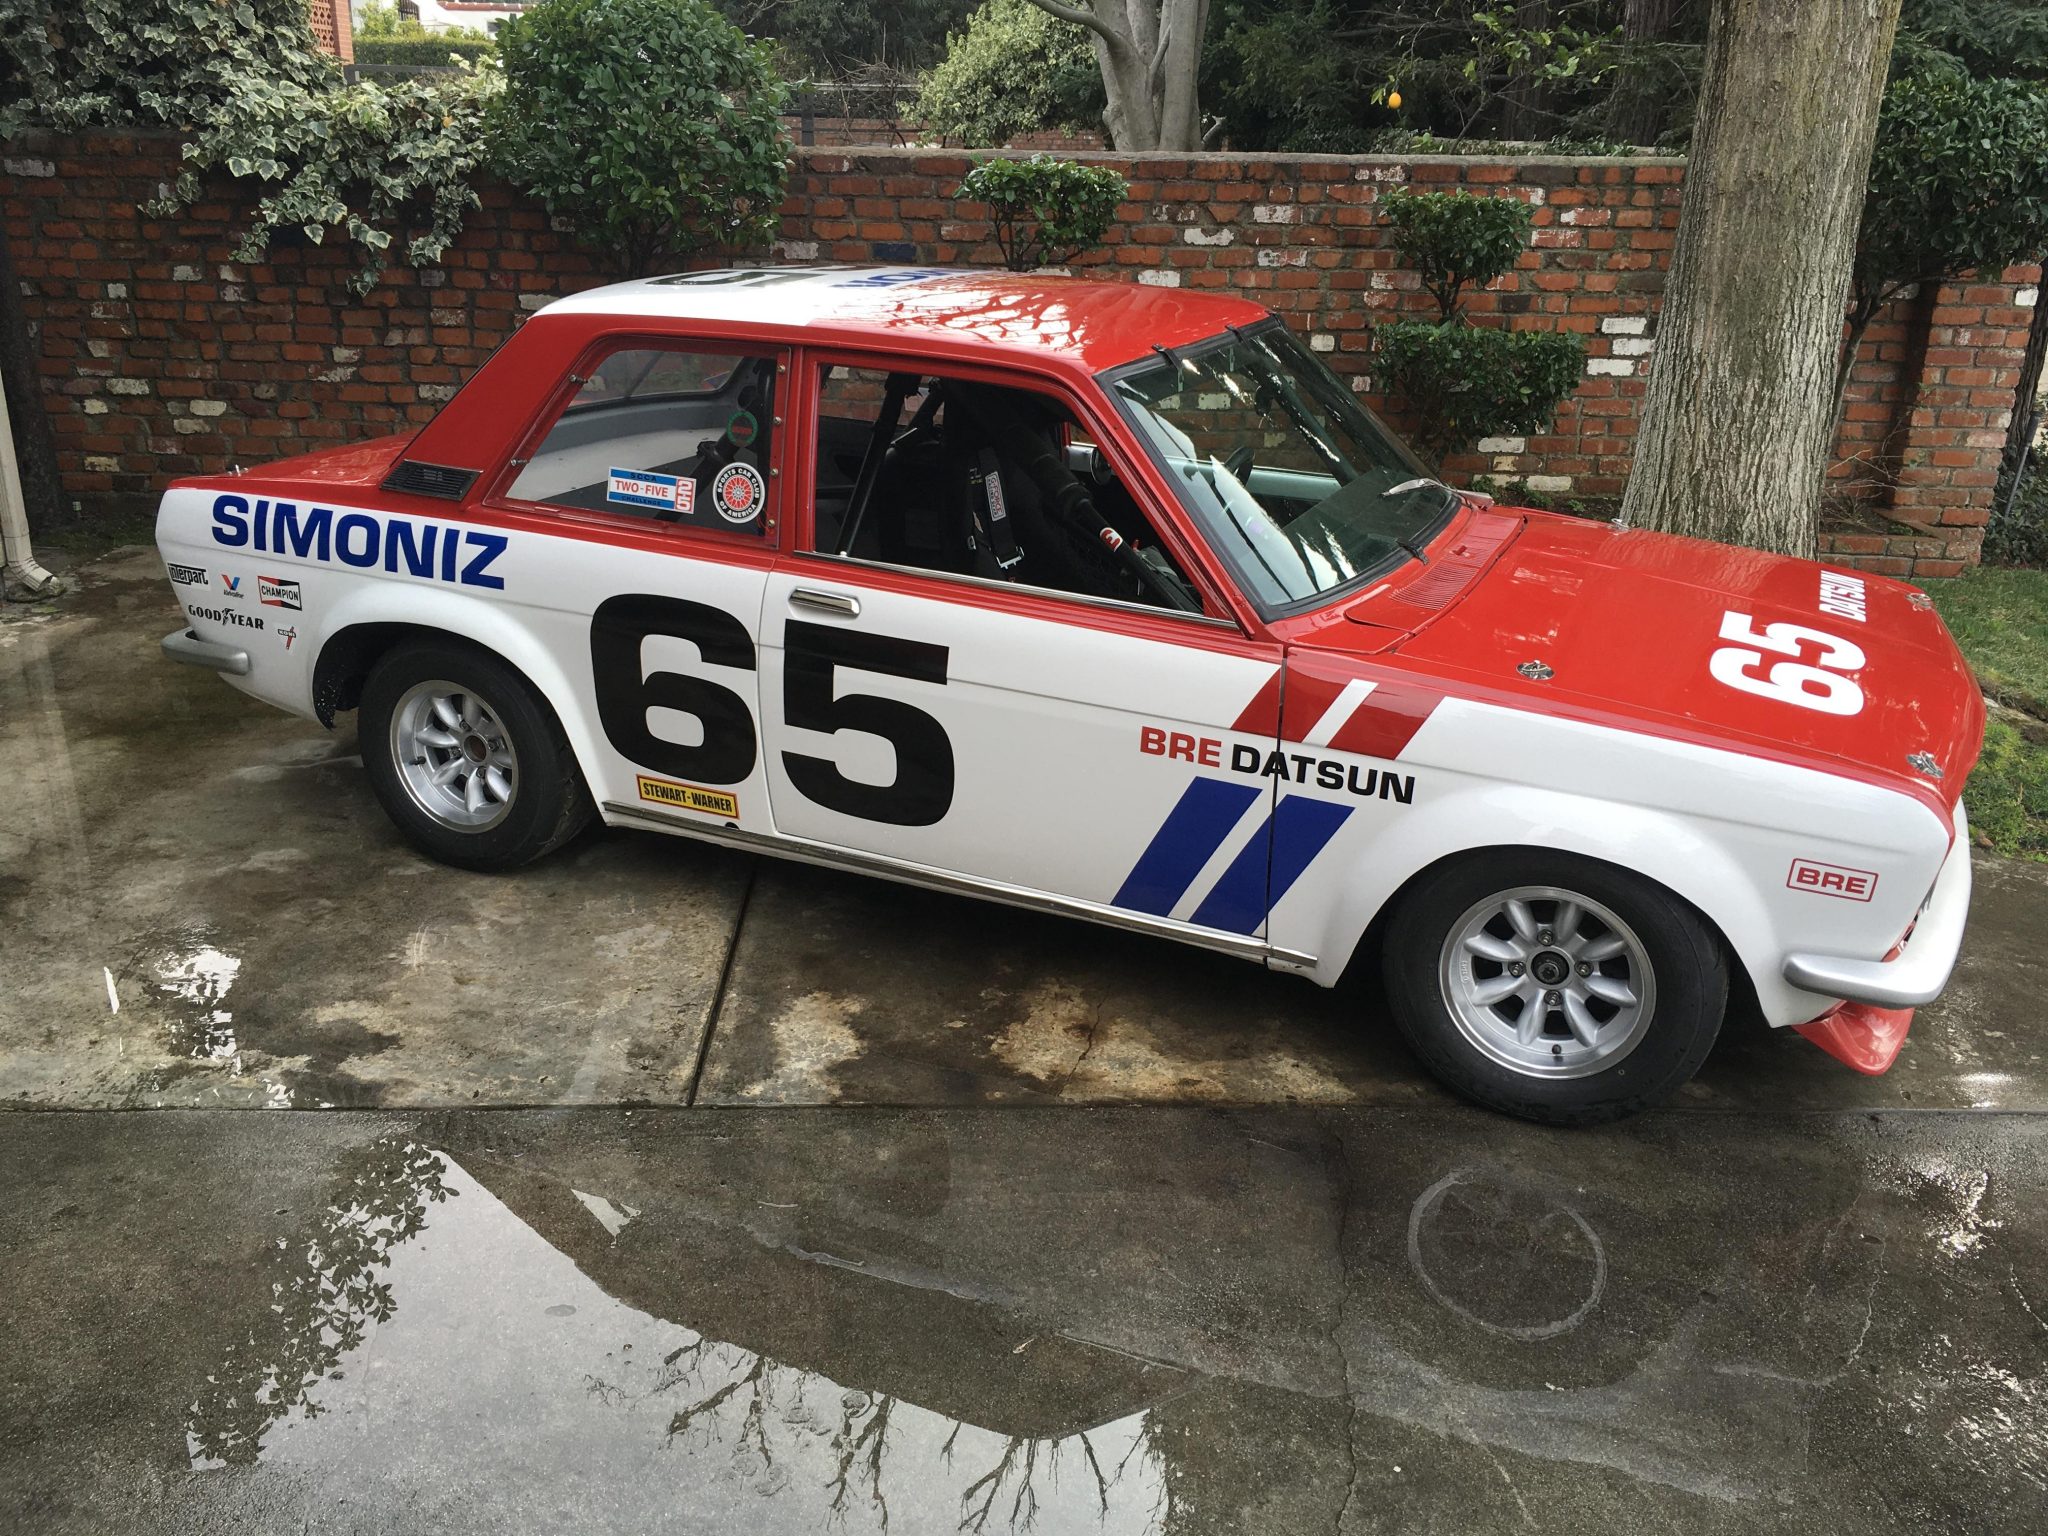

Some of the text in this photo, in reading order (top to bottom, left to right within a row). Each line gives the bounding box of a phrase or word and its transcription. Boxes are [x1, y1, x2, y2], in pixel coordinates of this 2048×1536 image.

[630, 473, 657, 481] SCCA
[717, 468, 760, 499] SPORTS CAR CLUB
[621, 495, 662, 506] CHALLENGE
[720, 500, 757, 518] OF AMERICA
[211, 494, 509, 591] SIMONIZ
[260, 585, 299, 601] CHAMPION
[1818, 570, 1867, 623] DATSUN
[1709, 610, 1866, 716] 65
[590, 593, 955, 827] 65
[1139, 725, 1416, 805] BRE DATSUN
[643, 782, 733, 813] STEWART-WARNER
[1796, 866, 1868, 895] BRE
